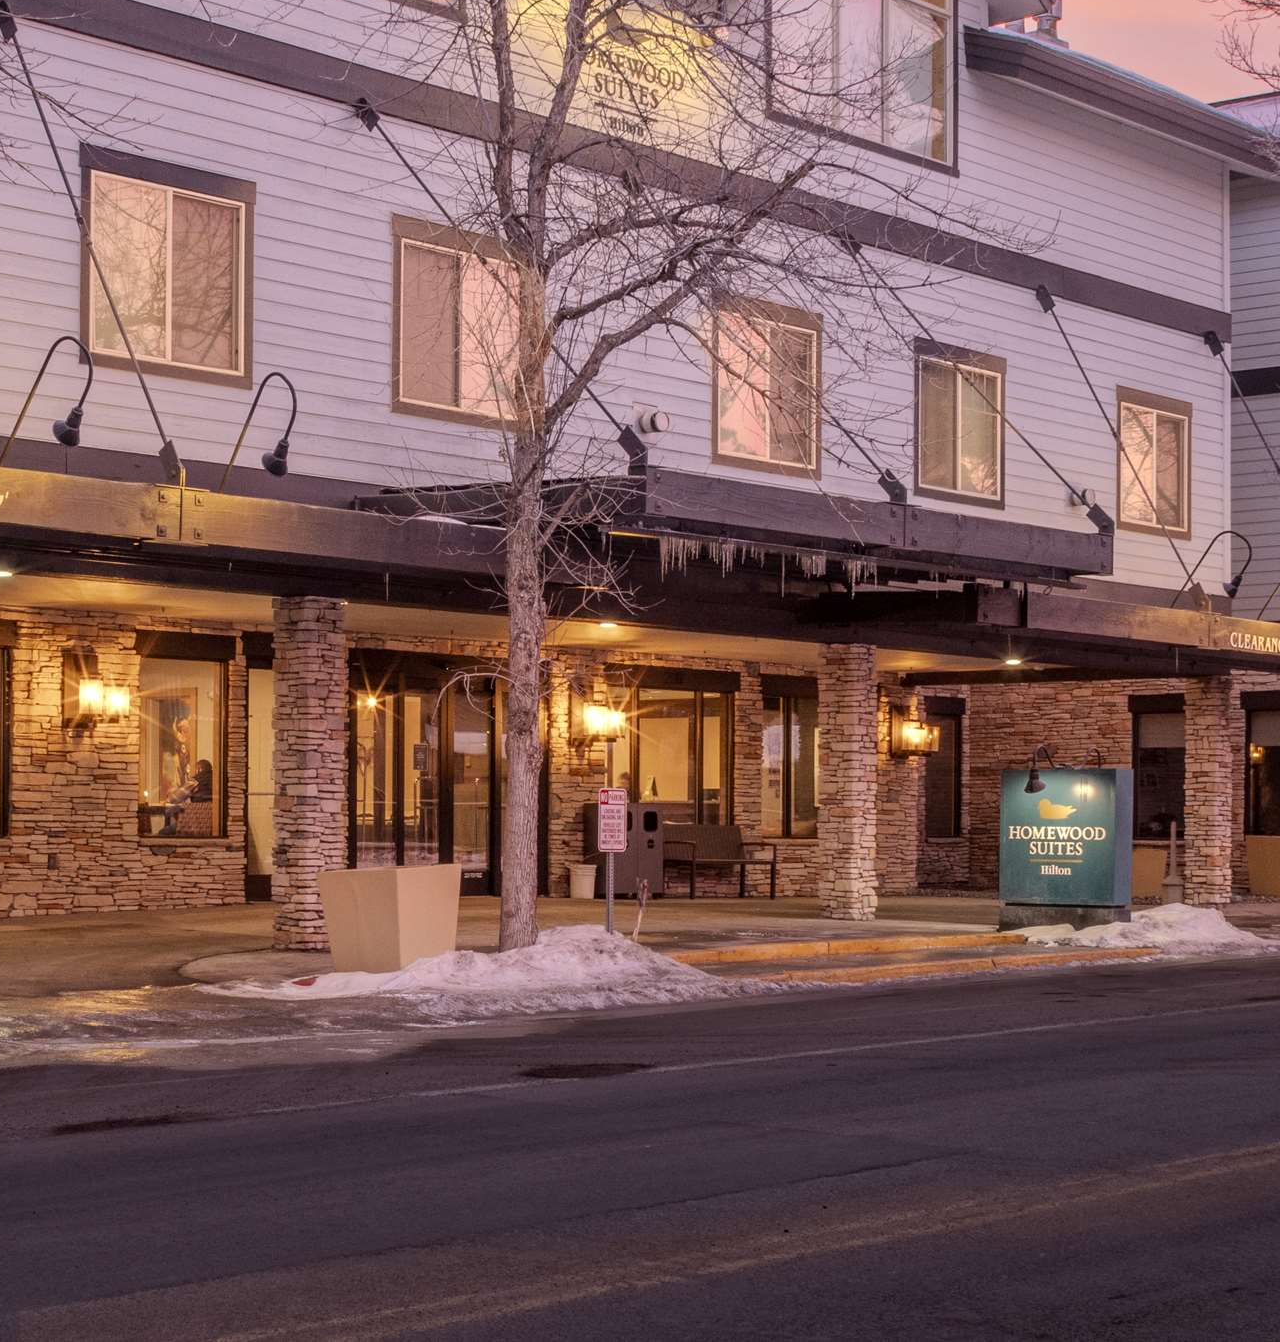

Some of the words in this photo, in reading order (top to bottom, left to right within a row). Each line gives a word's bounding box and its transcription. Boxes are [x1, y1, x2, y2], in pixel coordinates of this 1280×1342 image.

[583, 49, 684, 91] OMEWOOD
[1008, 825, 1106, 840] HOMEWOOD
[1029, 841, 1084, 856] SUITES
[1040, 864, 1073, 876] Hilton
